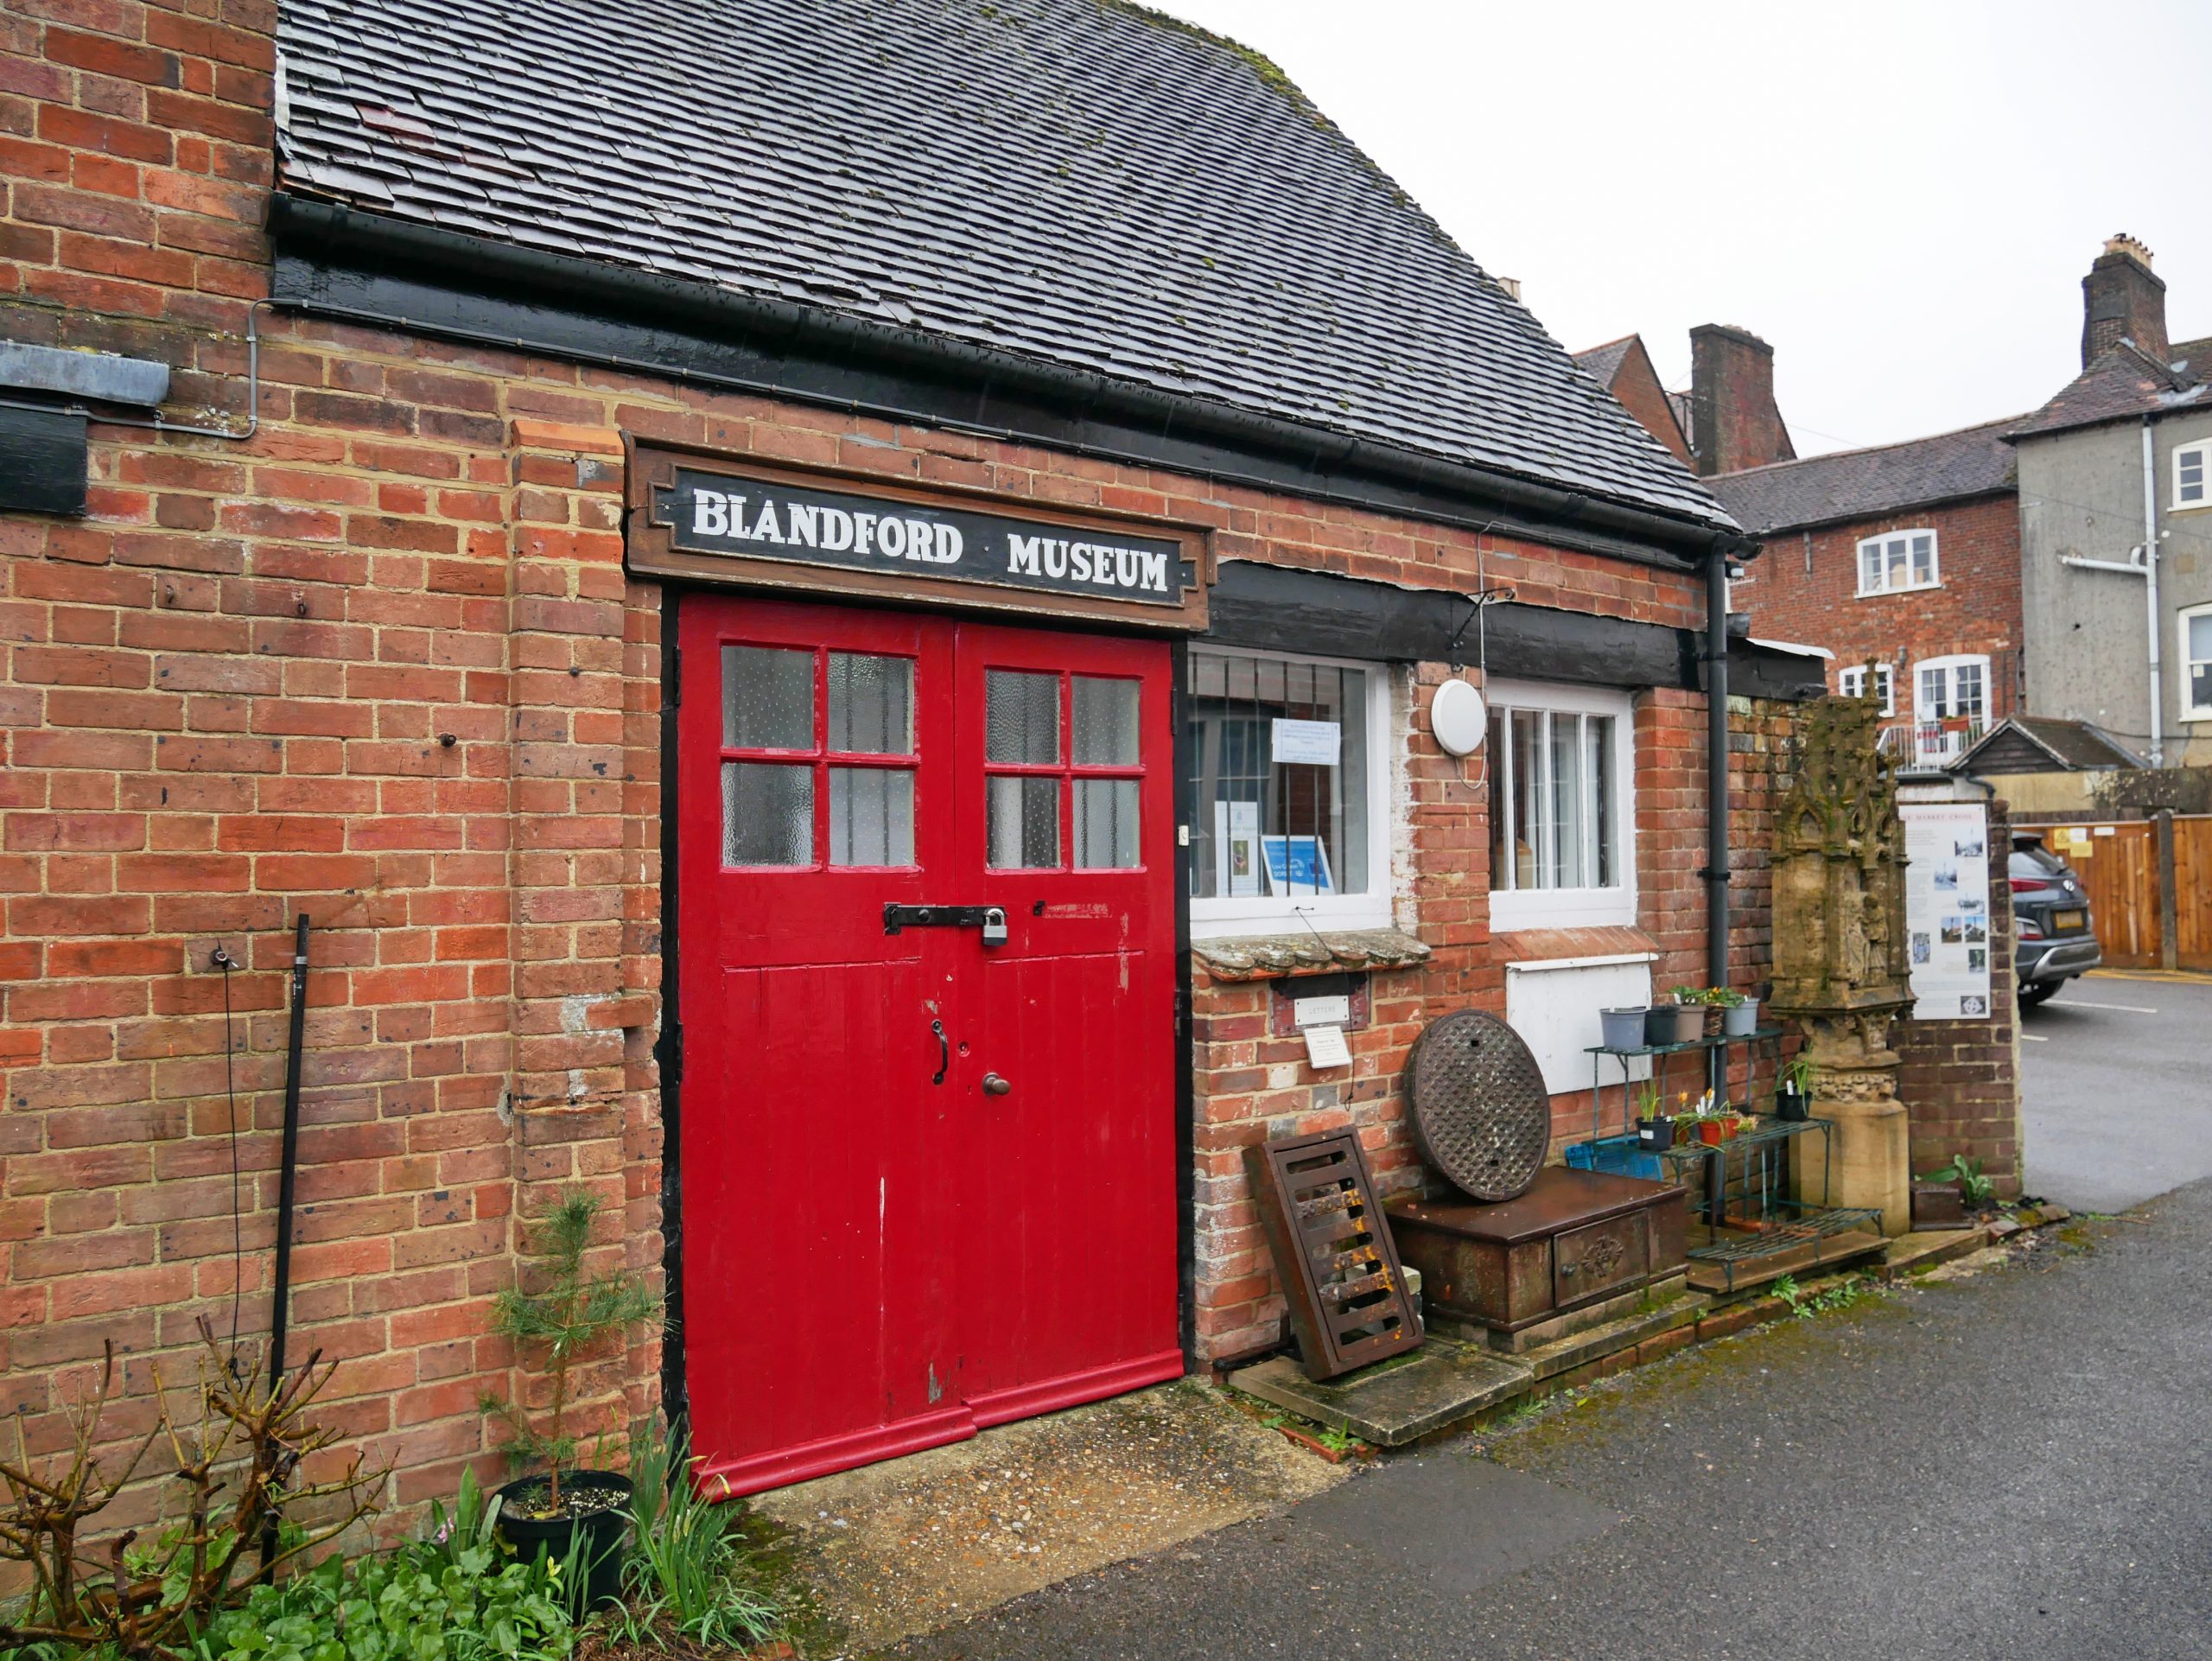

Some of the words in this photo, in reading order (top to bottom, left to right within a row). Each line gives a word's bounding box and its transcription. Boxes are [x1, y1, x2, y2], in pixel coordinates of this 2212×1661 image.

[692, 487, 963, 564] BLANDFORD
[1007, 533, 1168, 592] MUSEUM
[1309, 1006, 1335, 1015] LETTERS
